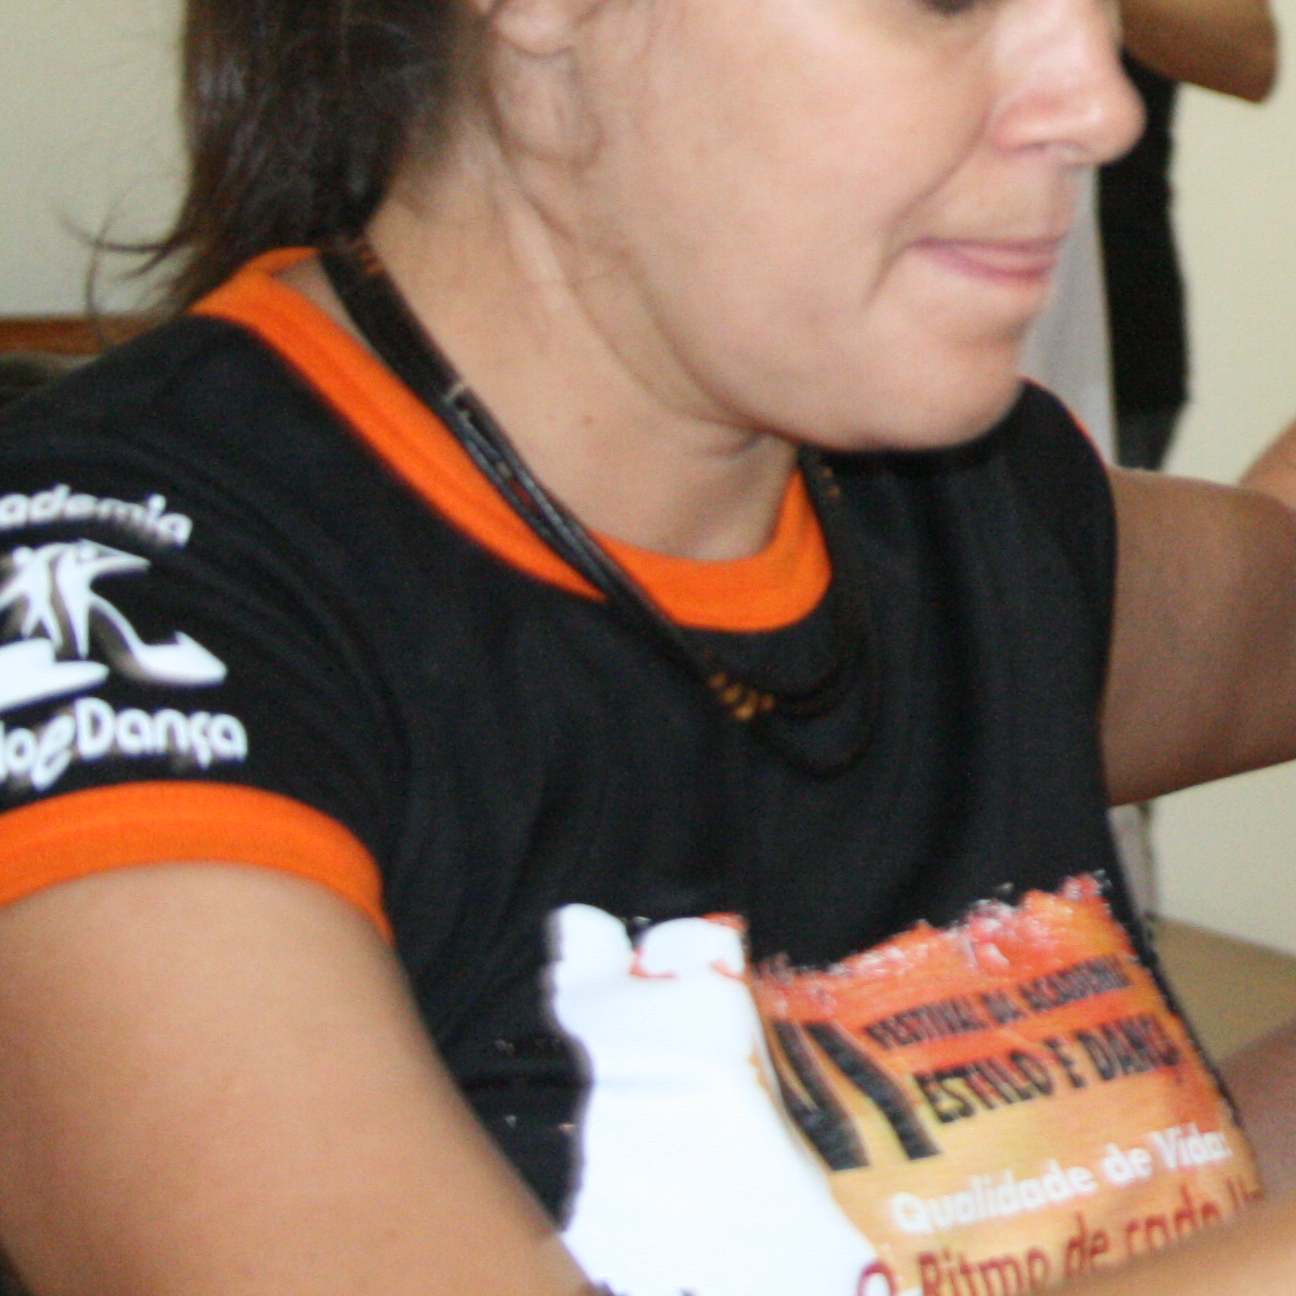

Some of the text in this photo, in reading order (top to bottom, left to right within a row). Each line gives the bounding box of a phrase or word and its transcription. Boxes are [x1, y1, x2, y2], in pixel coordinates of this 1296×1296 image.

[913, 1051, 1056, 1123] ESTILO
[891, 1157, 1097, 1233] Qualidade
[1101, 1142, 1153, 1186] de
[918, 1246, 1050, 1296] Ritmo
[1066, 1212, 1110, 1272] de
